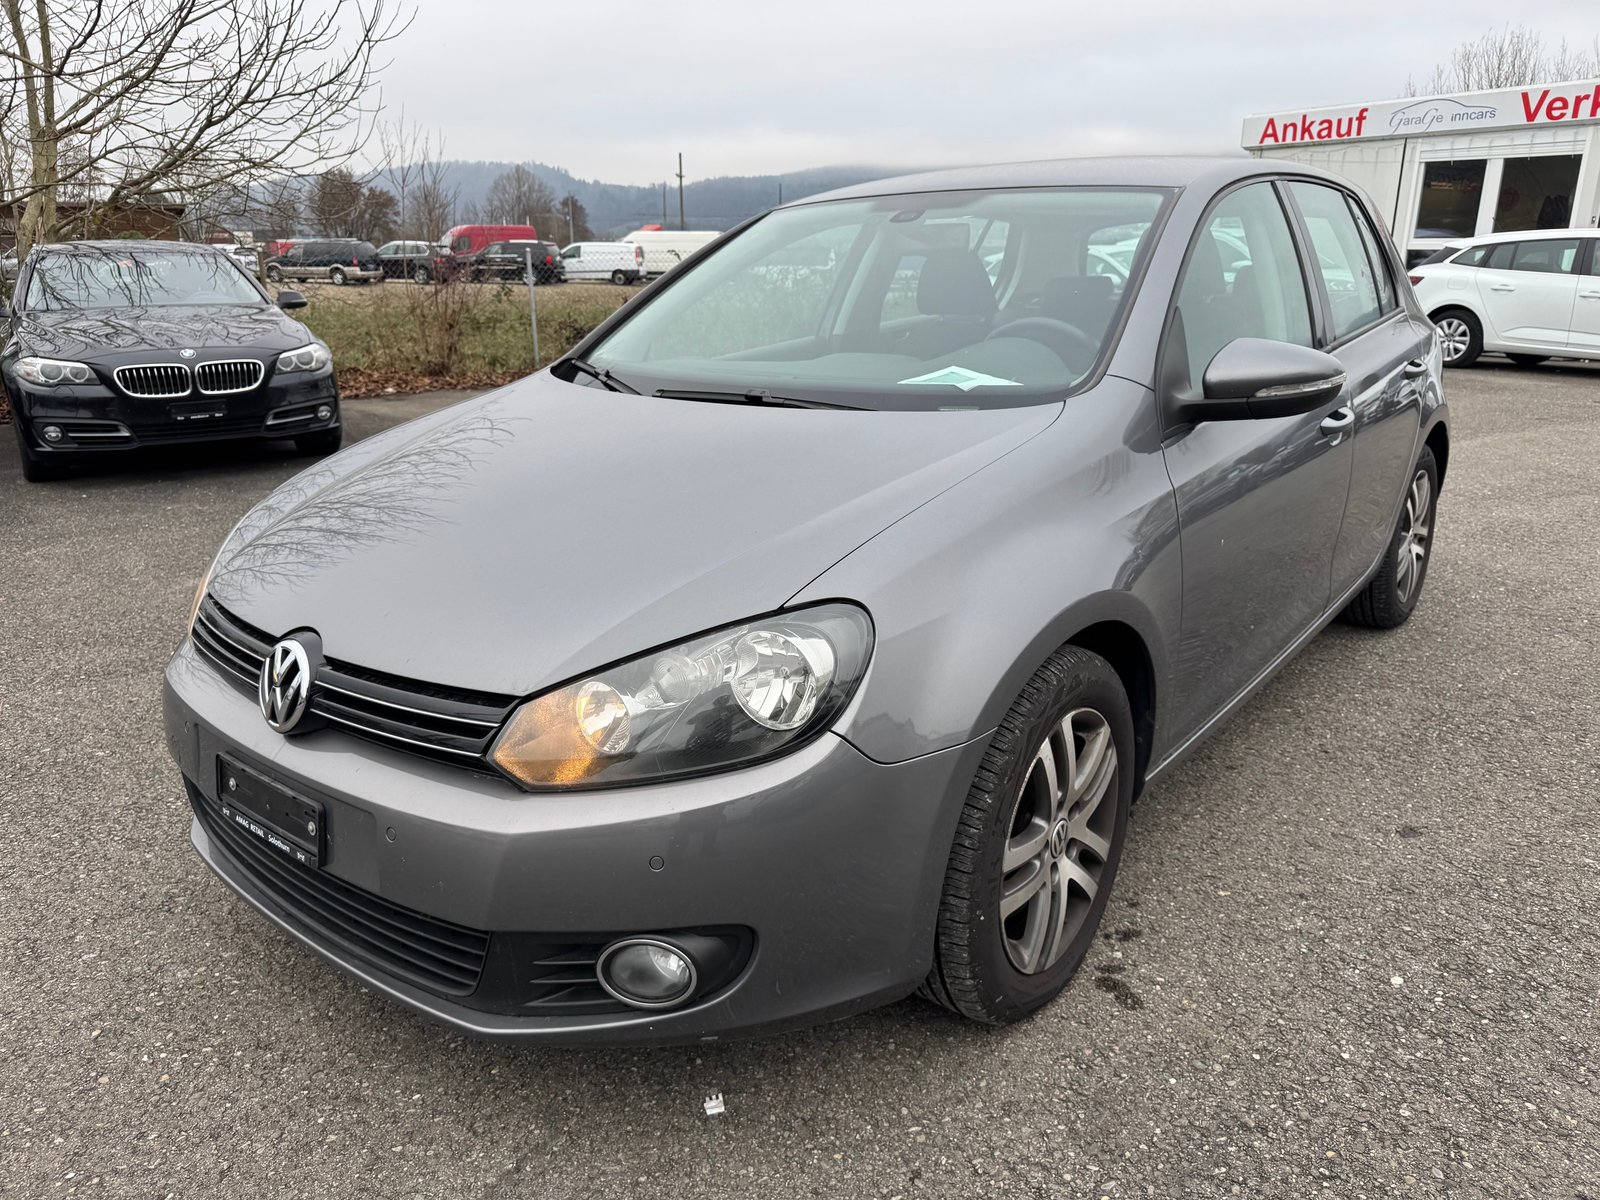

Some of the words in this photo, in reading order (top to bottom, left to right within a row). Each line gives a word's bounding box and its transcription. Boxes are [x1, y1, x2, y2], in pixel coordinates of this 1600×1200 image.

[1259, 107, 1369, 145] Ankauf
[1450, 109, 1496, 122] inncars
[235, 815, 249, 829] AMAG
[250, 823, 265, 838] RETAIL
[268, 834, 290, 853] Solothurn
